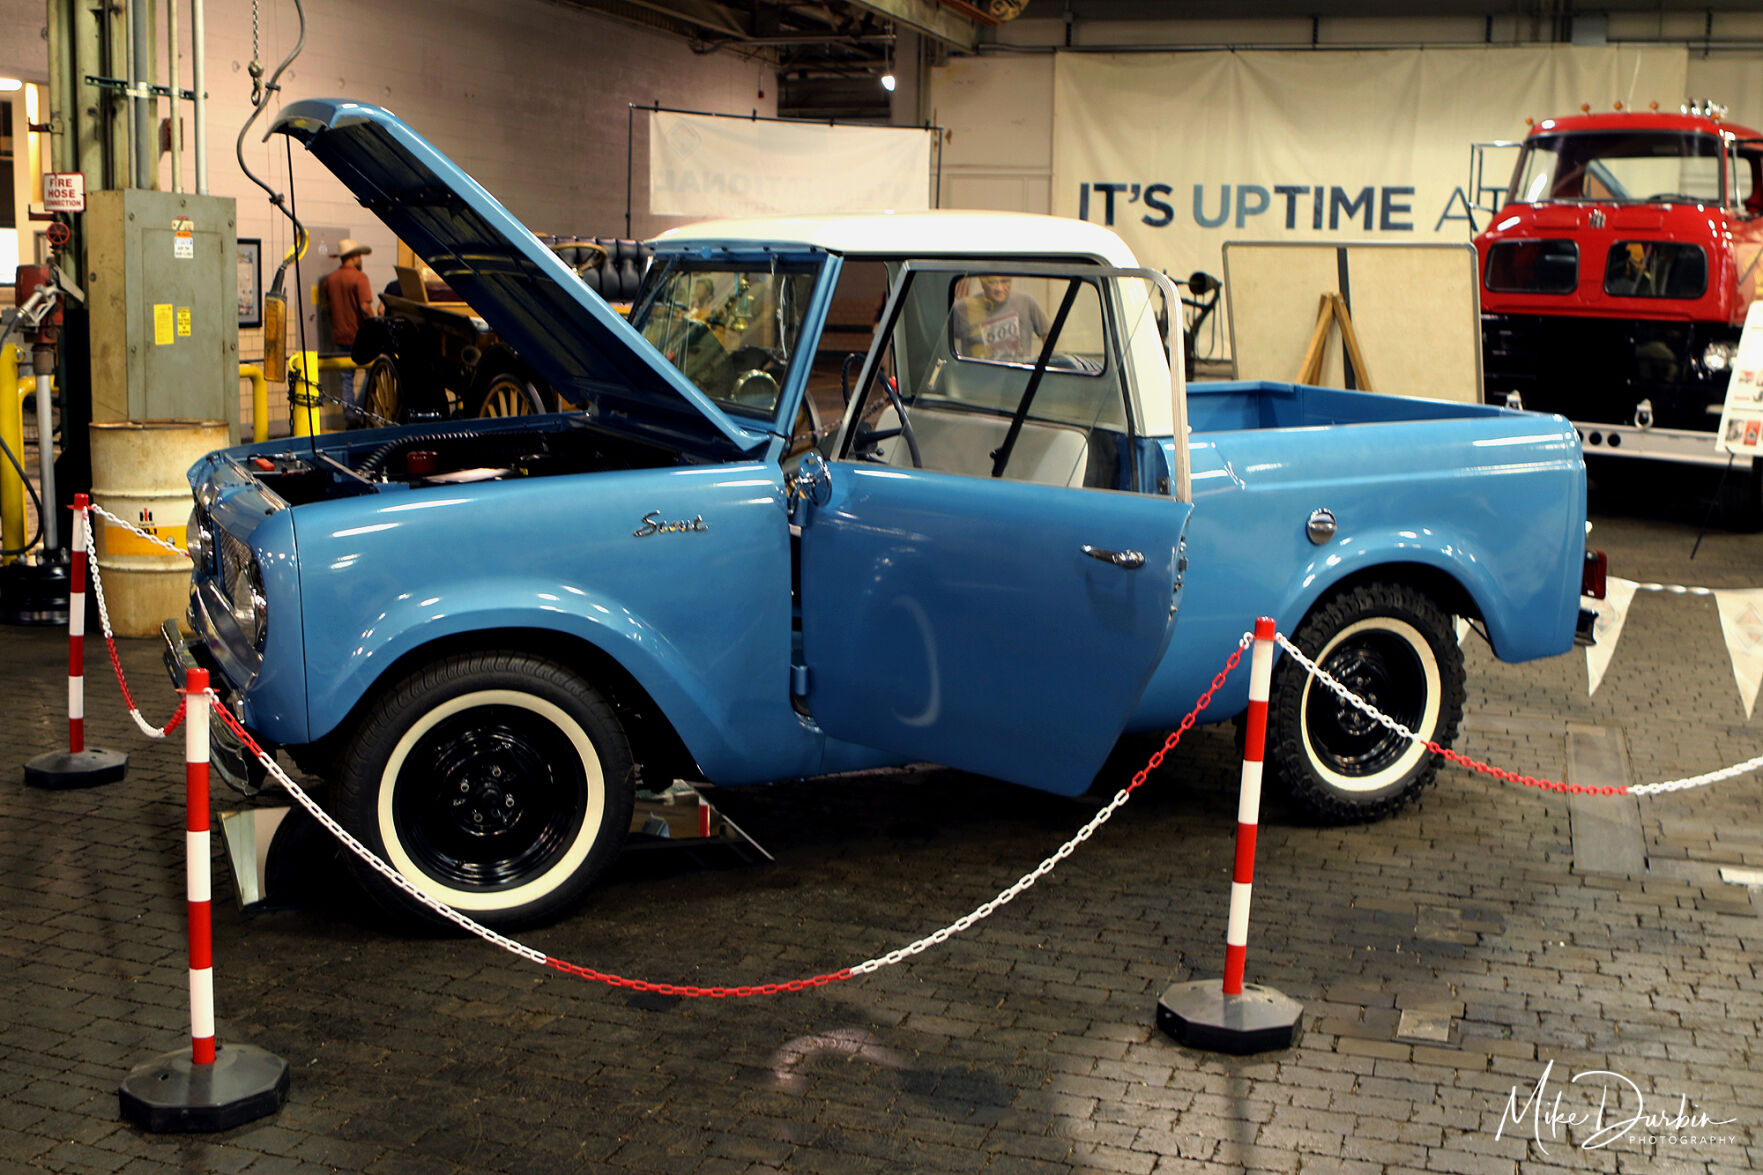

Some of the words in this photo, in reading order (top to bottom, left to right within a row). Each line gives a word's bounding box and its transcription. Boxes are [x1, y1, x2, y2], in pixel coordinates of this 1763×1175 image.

[49, 178, 72, 187] FIRE
[48, 189, 76, 198] HOSE
[1079, 182, 1174, 227] IT'S
[1192, 184, 1415, 231] UPTIME
[633, 509, 709, 537] Scout
